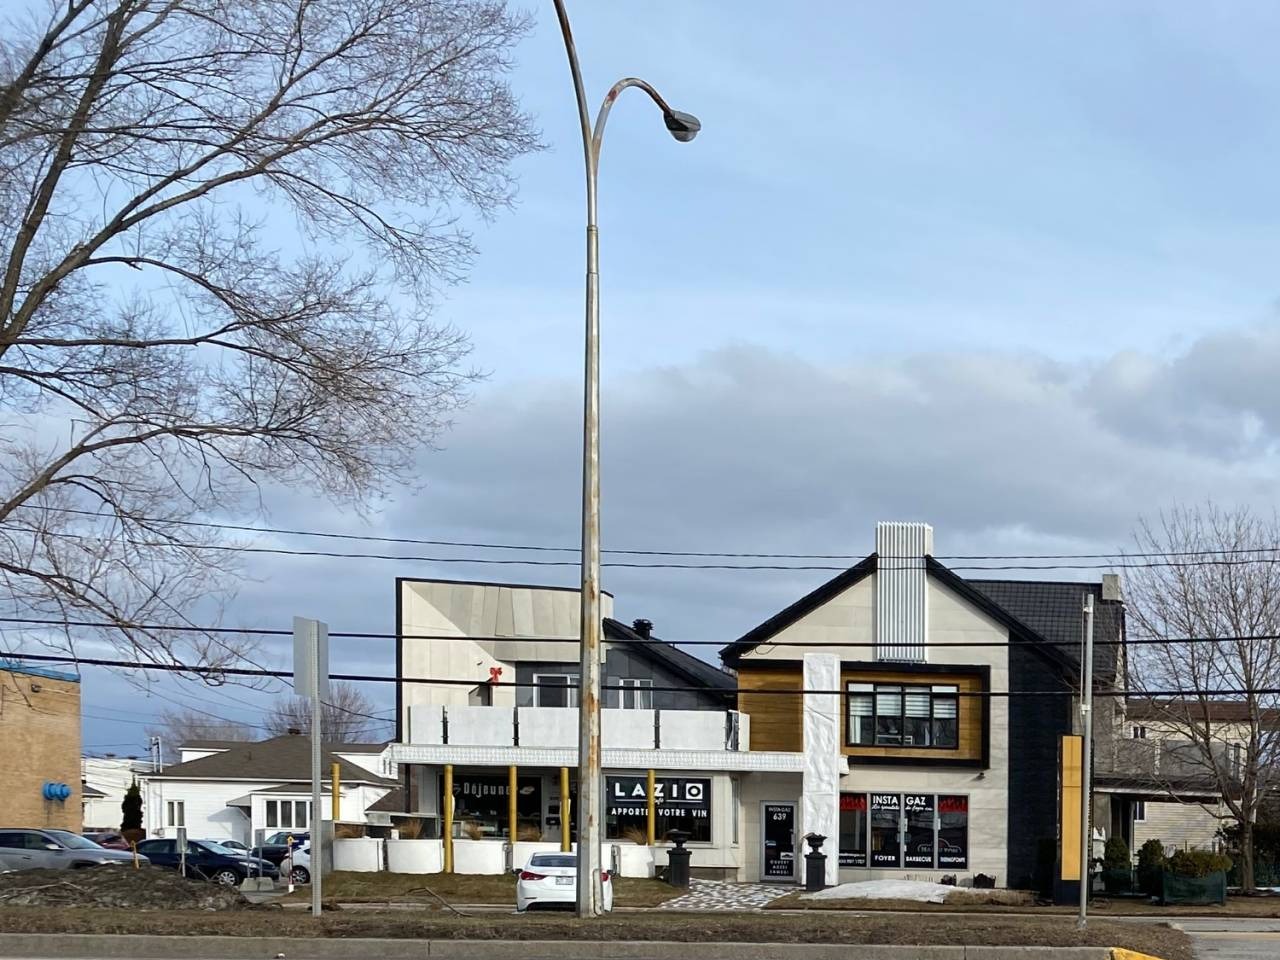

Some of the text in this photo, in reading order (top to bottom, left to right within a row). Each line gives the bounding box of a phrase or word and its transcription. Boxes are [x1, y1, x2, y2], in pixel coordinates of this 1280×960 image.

[614, 782, 703, 799] LAZIO
[872, 795, 926, 806] INSTA GAZ
[611, 807, 708, 818] APPORTE VOTRE VIN
[773, 812, 787, 821] 639
